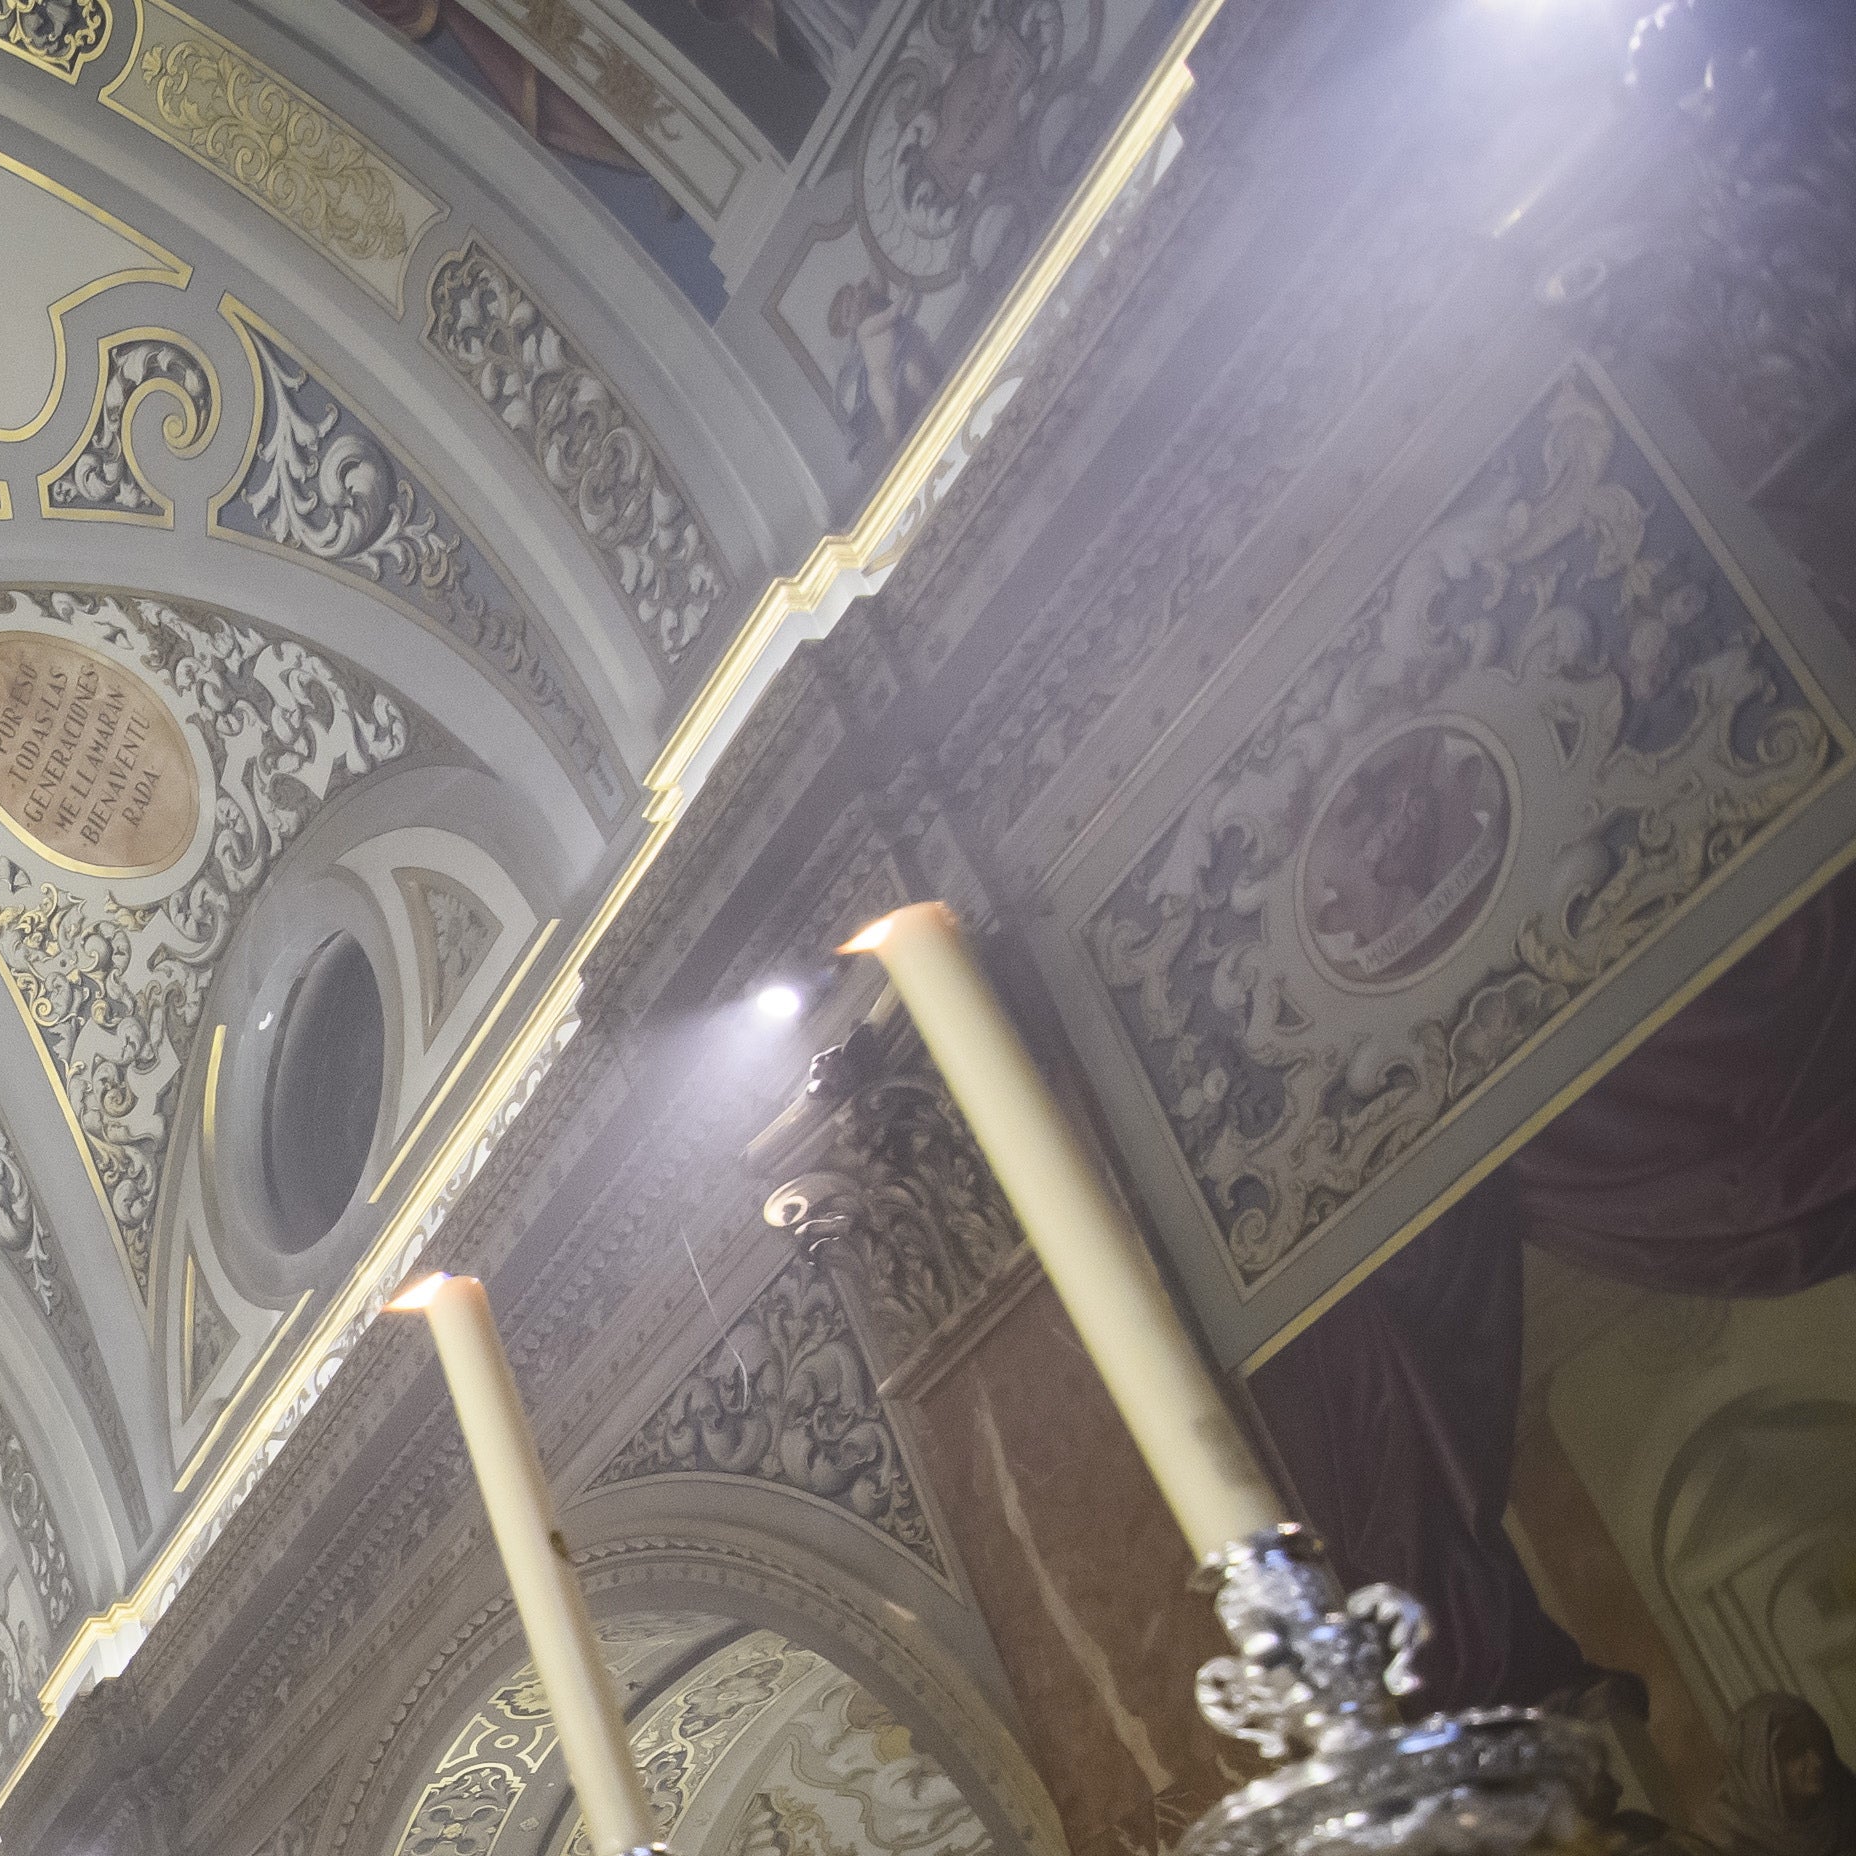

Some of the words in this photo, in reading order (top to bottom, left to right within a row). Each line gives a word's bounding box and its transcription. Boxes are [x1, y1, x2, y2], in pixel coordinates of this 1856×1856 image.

[10, 663, 38, 707] ESO
[8, 708, 53, 783] TODAS
[41, 667, 68, 711] LAS
[24, 665, 99, 823] GENERACIONES
[54, 797, 81, 832] ME
[121, 770, 161, 826] RADA
